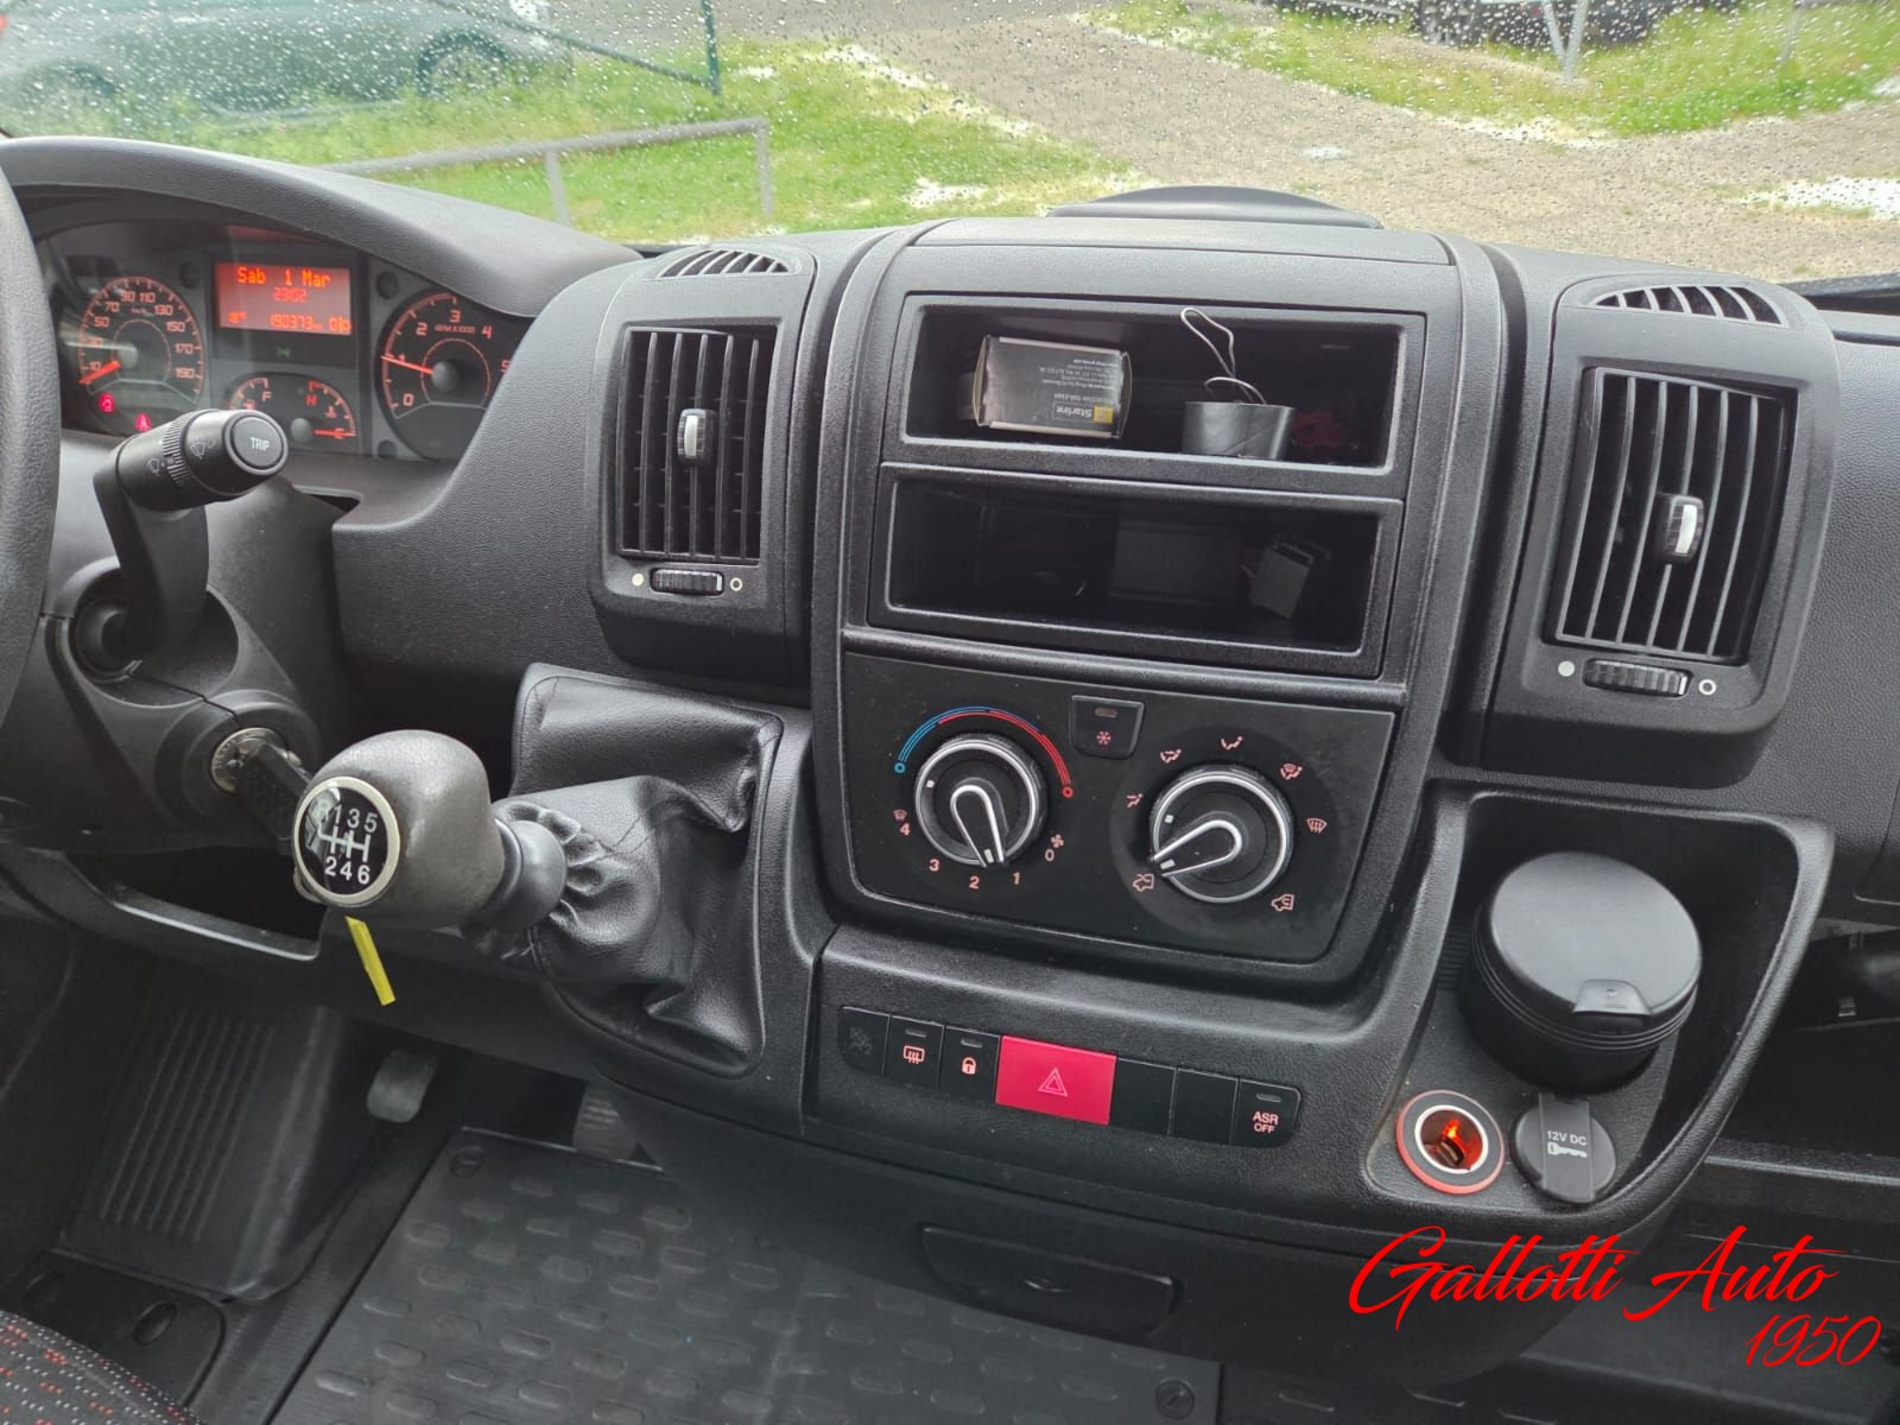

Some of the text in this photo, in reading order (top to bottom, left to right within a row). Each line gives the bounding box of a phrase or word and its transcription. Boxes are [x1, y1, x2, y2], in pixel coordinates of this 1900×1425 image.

[237, 266, 331, 288] Sab 1 Mar
[139, 292, 155, 303] 110
[105, 301, 120, 313] 70
[154, 305, 173, 316] 130
[94, 316, 110, 328] 50
[449, 309, 461, 323] 3
[165, 321, 185, 332] 150
[416, 322, 428, 336] 2
[481, 325, 493, 339] 4
[175, 344, 193, 354] 170
[262, 391, 272, 402] F
[305, 395, 317, 405] H
[402, 393, 414, 407] 0
[250, 437, 270, 450] TRIP
[333, 805, 343, 824] 1
[347, 808, 360, 828] 3
[364, 813, 378, 833] 5
[899, 822, 911, 836] 4
[1044, 849, 1055, 862] 0
[324, 857, 371, 885] 2 4 6
[928, 858, 940, 872] 3
[969, 875, 980, 890] 2
[1012, 872, 1021, 885] 1
[1252, 1111, 1279, 1127] ASR
[1254, 1122, 1277, 1135] OFF
[1546, 1130, 1587, 1147] 12V DC
